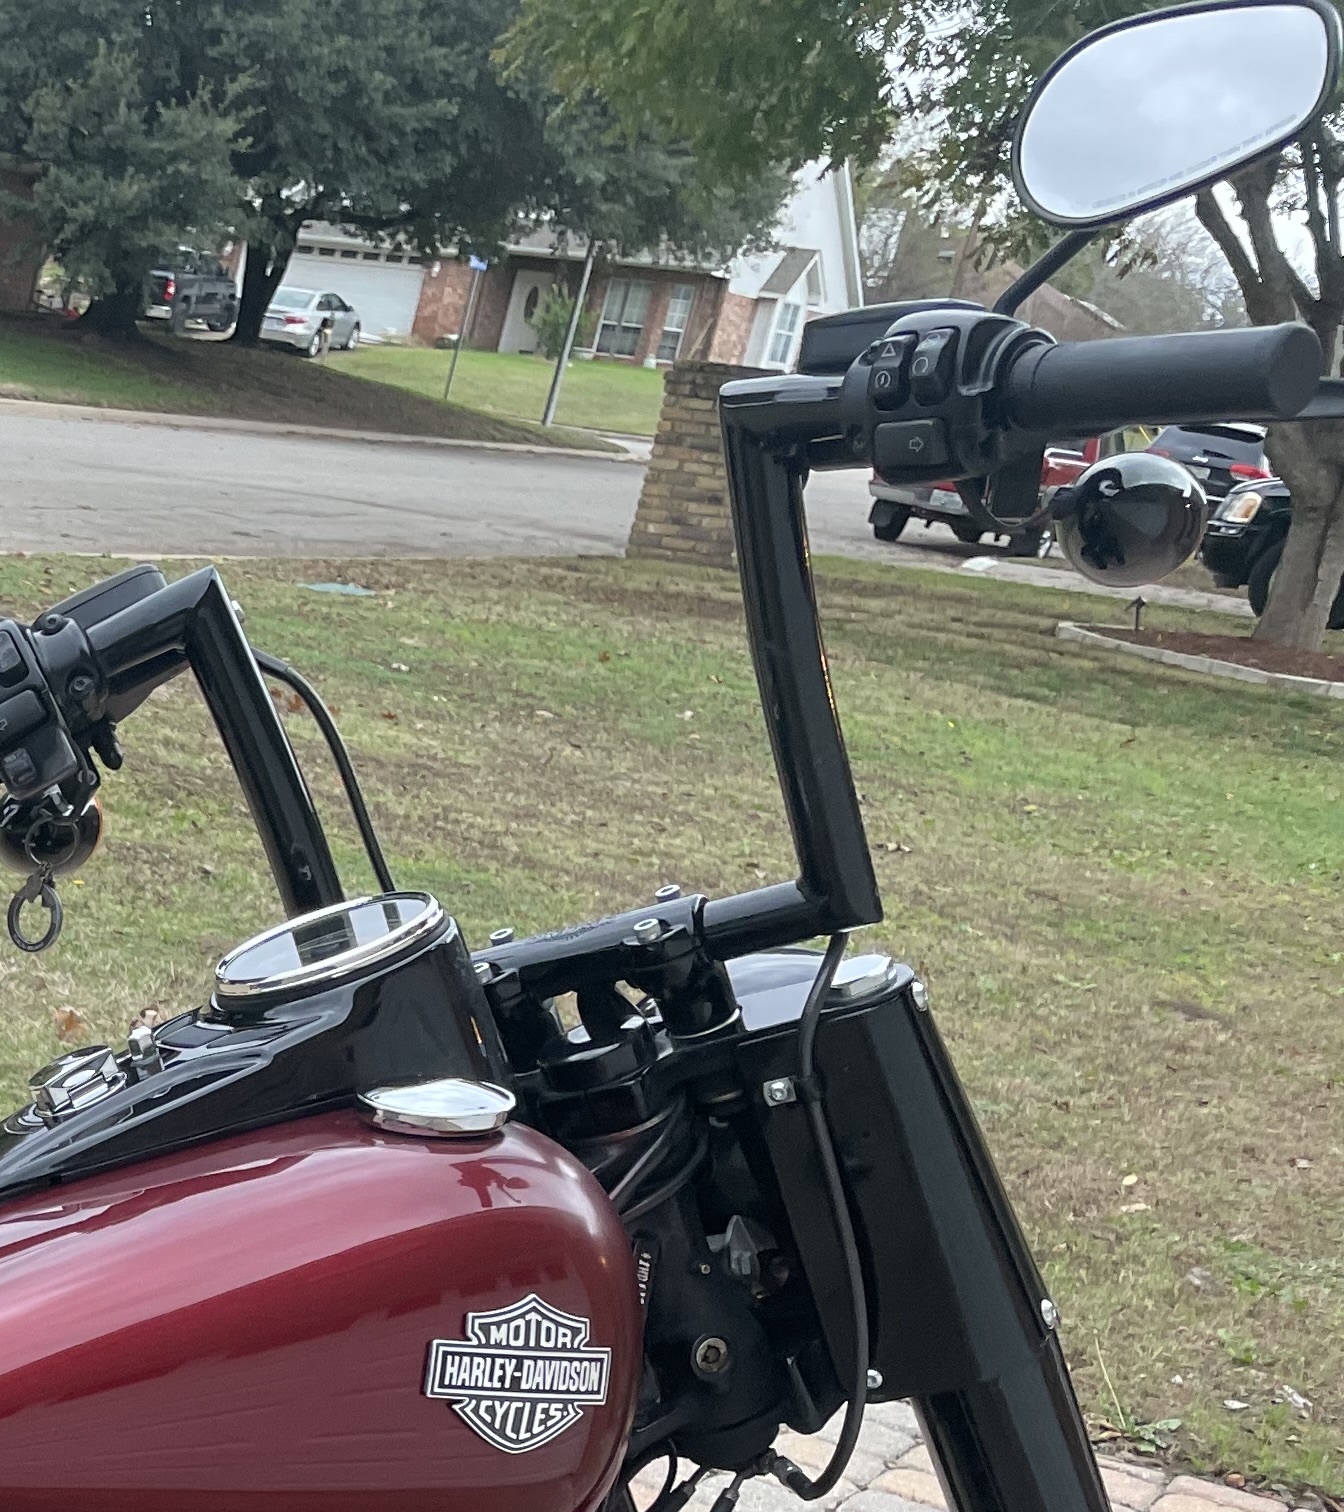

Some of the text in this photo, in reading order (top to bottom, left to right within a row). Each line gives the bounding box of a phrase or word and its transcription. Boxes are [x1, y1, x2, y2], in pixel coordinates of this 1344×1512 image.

[490, 1311, 572, 1349] MOTOR
[444, 1354, 601, 1392] HARLEY-DAVIDSON
[478, 1399, 562, 1440] CYCLES
